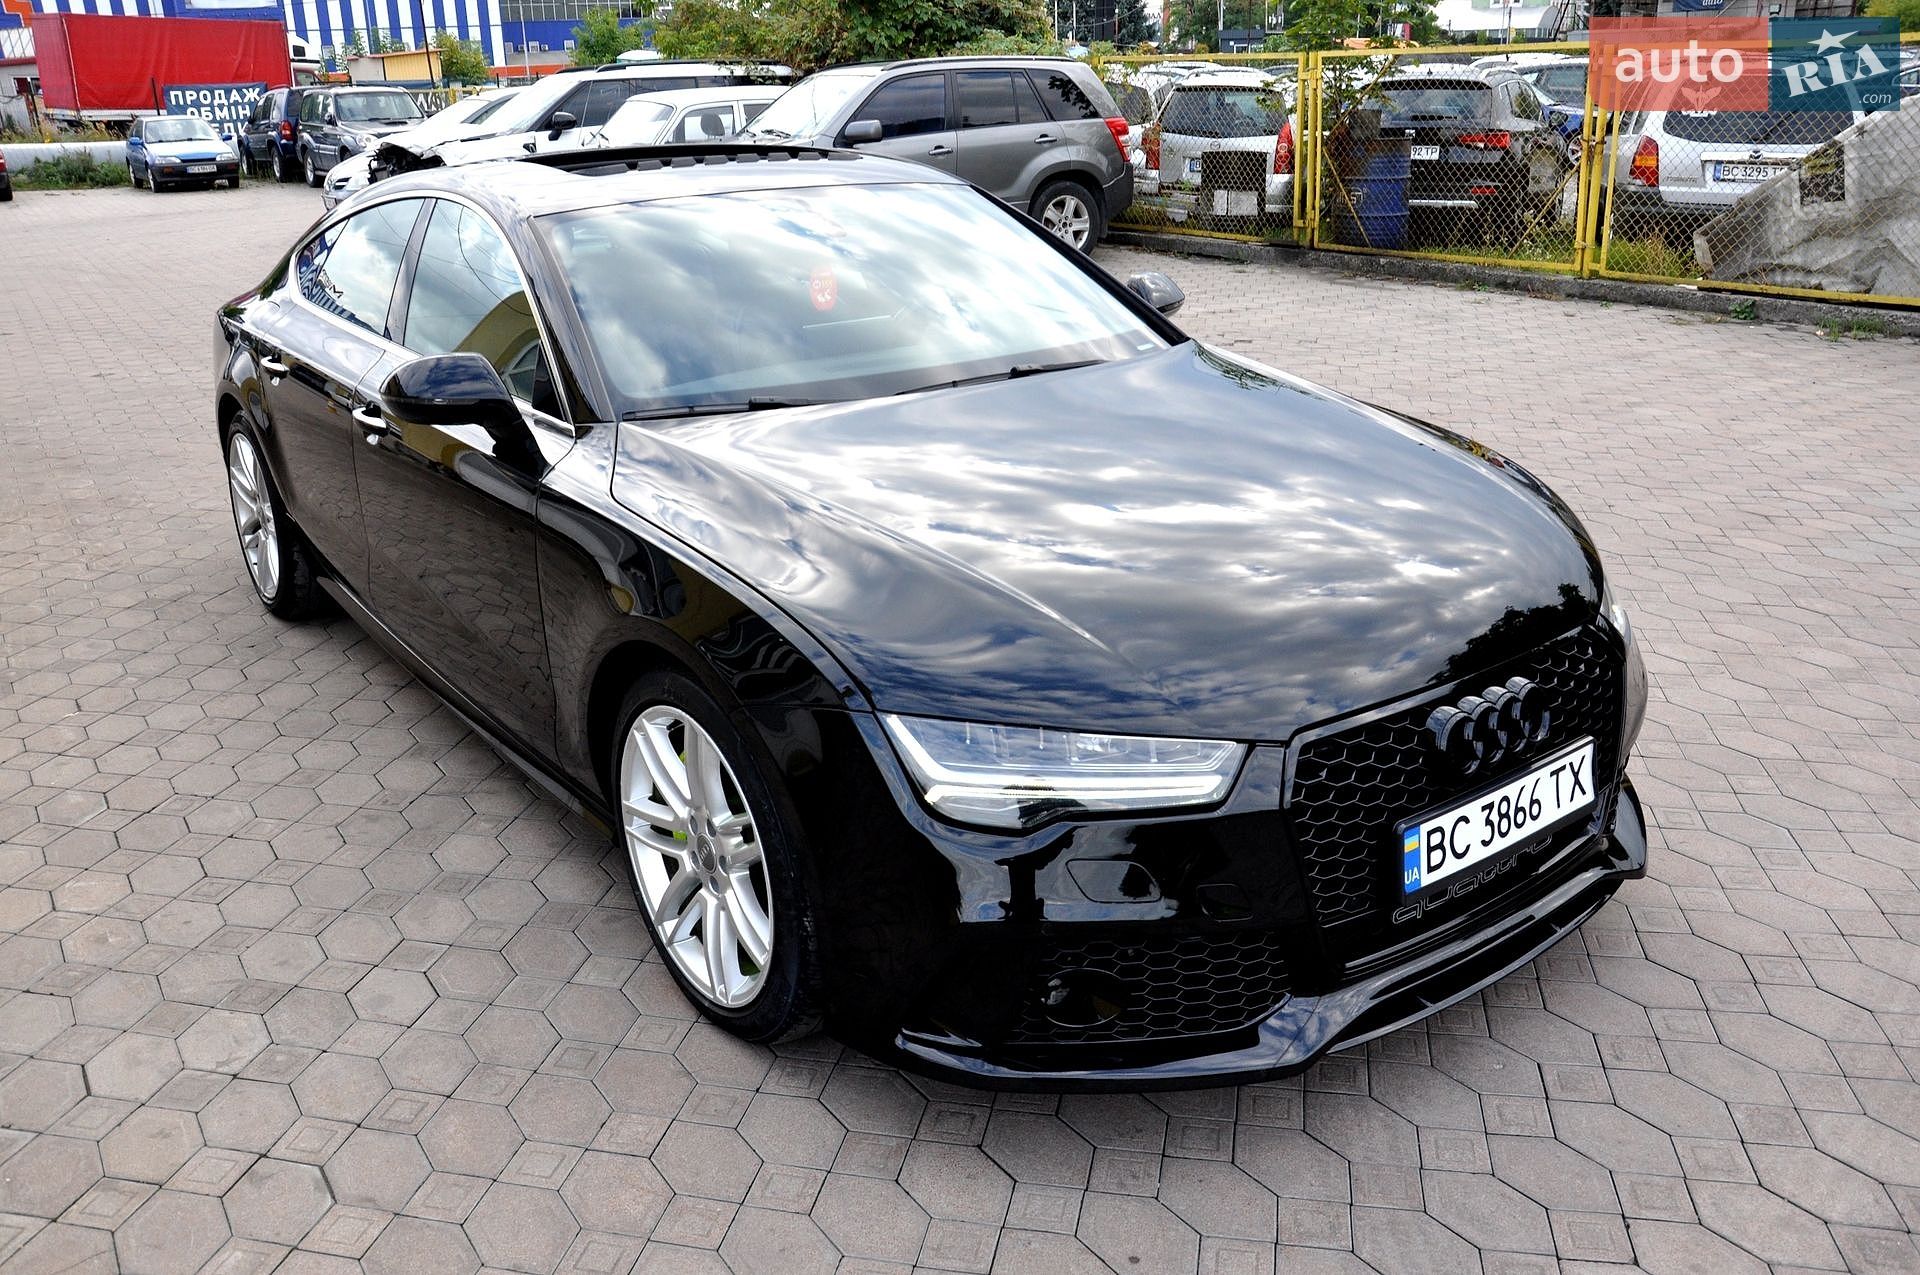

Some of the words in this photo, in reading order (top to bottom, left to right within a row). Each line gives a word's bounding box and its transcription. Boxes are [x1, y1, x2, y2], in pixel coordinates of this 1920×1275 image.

[169, 88, 261, 106] ПРОДАЖ
[186, 104, 251, 121] ОБМІН
[1722, 165, 1739, 177] BC
[1741, 166, 1769, 178] 3295
[1426, 815, 1471, 875] BC
[1480, 777, 1542, 847] 3866
[1550, 754, 1587, 809] TX
[1404, 869, 1420, 885] UA
